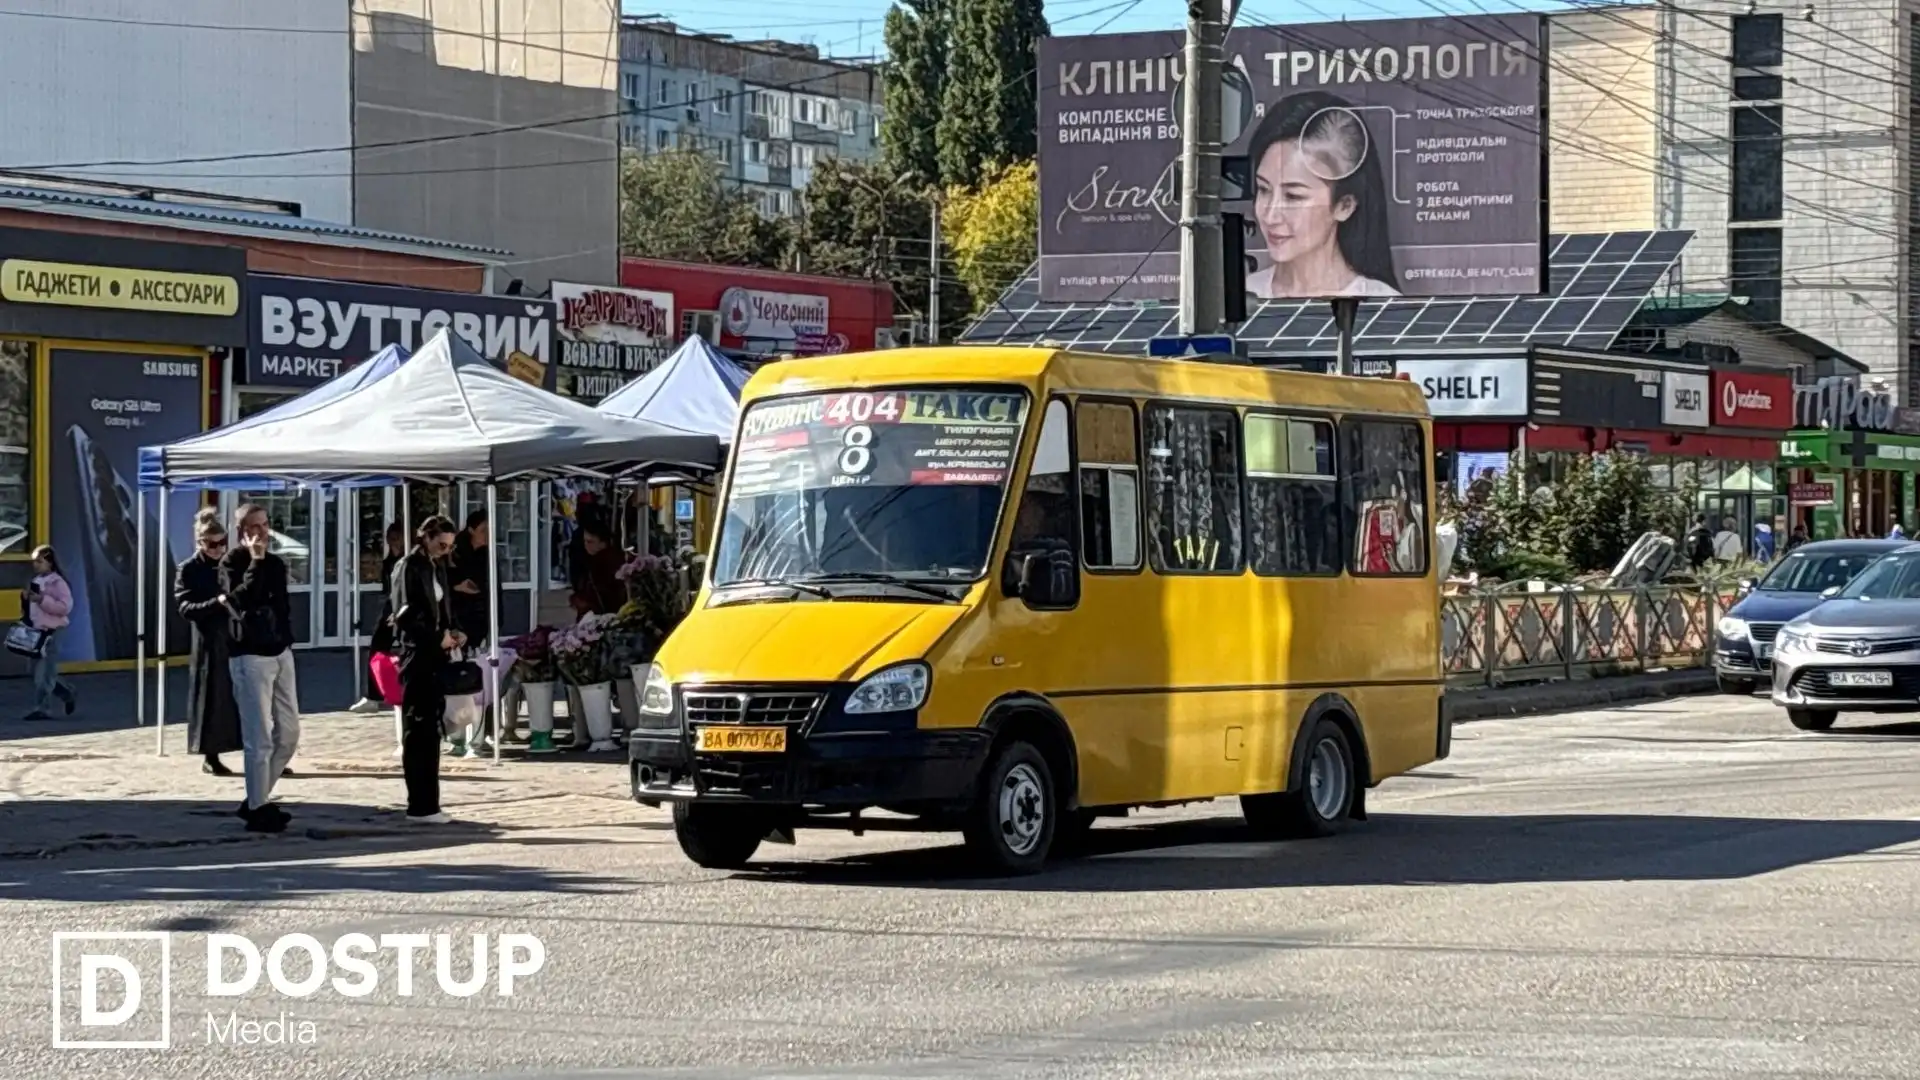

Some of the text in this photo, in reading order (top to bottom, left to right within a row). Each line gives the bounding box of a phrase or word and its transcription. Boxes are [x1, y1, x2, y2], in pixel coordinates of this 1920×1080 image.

[1264, 40, 1528, 87] ТРИХОЛОГІЯ
[1058, 106, 1167, 126] КОМПЛЕКСНЕ
[1416, 109, 1453, 120] ТОЧНА
[1058, 126, 1151, 144] ВИПАДІННЯ
[1416, 137, 1507, 149] ІНДИВІДУАЛЬНІ
[1416, 152, 1485, 163] ПРОТОКОЛИ
[1416, 182, 1460, 192] РОБОТА
[1416, 195, 1513, 209] З ДЕФІЦИТНИМИ
[1416, 211, 1471, 222] СТАНАМИ
[16, 269, 225, 306] ГАДЖЕТИ АКСЕСУАРИ
[1060, 276, 1098, 287] ВУЛИЦЯ
[752, 295, 825, 328] Червоний
[143, 361, 198, 377] SAMSUNG
[261, 354, 343, 378] МАРКЕТ
[1424, 375, 1499, 400] SHELFI
[91, 398, 123, 414] Galaxy
[829, 392, 898, 422] 404
[1737, 389, 1773, 410] vodafone
[838, 424, 875, 475] 8
[727, 732, 759, 748] 0070
